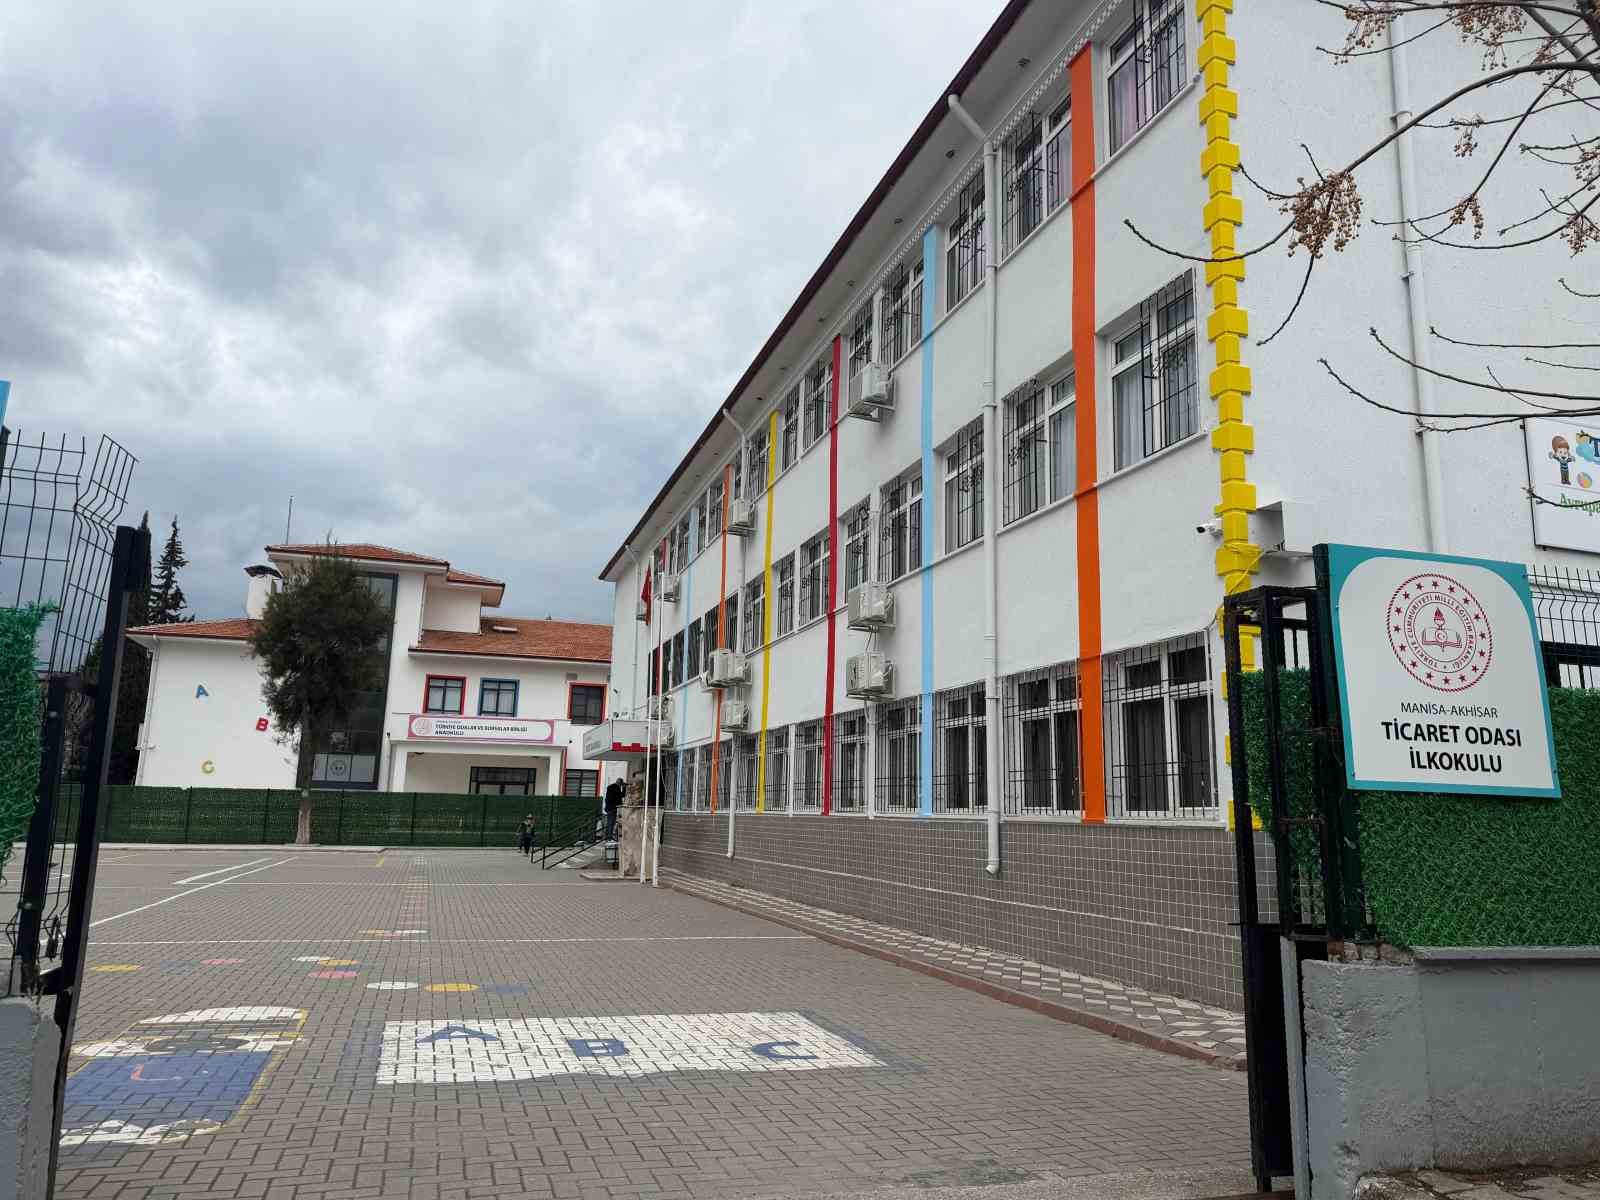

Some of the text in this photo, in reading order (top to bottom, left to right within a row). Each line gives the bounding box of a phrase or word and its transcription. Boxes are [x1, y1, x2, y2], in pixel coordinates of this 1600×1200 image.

[195, 684, 209, 698] A
[1400, 701, 1498, 718] MANİSA-AKHİSAR
[256, 717, 269, 732] B
[1381, 718, 1522, 747] TİCARET ODASI
[201, 760, 215, 774] C
[1409, 746, 1503, 773] İLKOKULU
[416, 1024, 817, 1060] A B C
